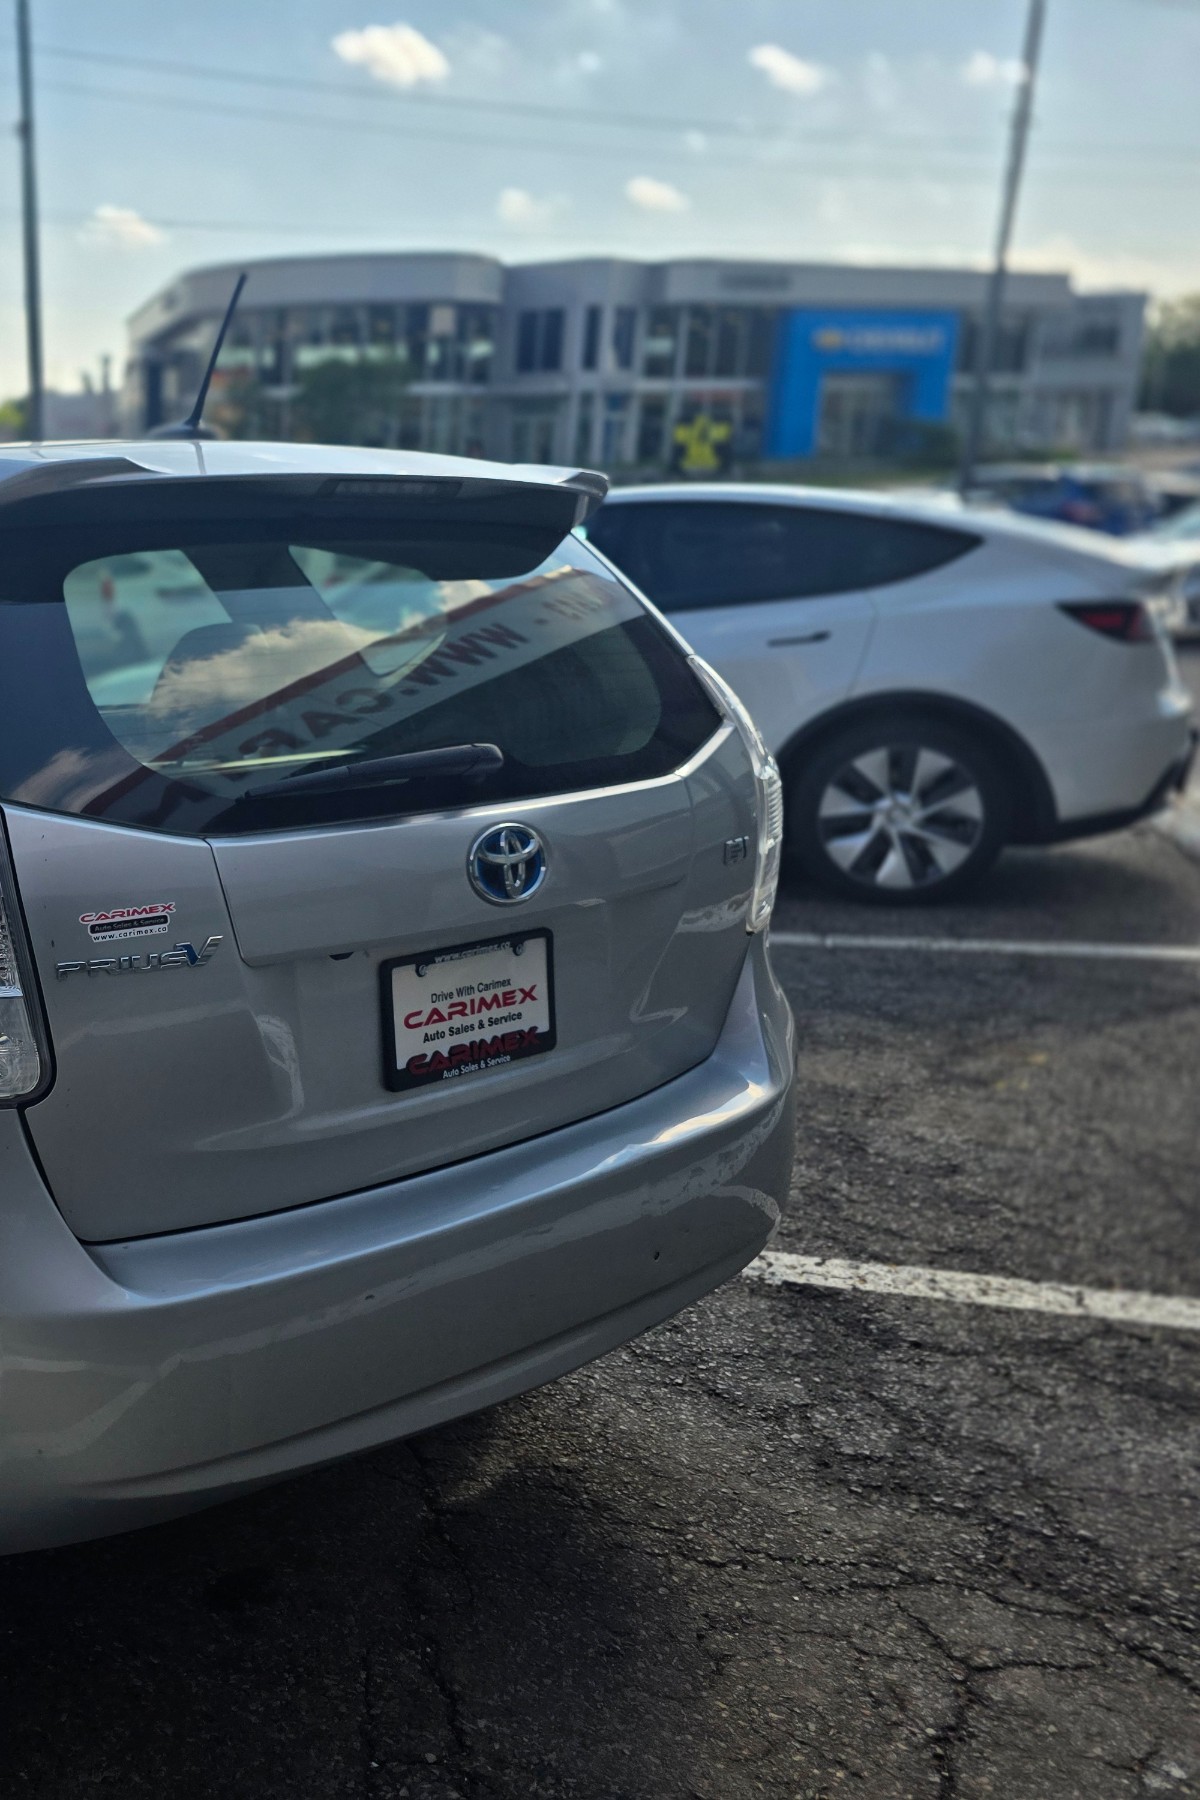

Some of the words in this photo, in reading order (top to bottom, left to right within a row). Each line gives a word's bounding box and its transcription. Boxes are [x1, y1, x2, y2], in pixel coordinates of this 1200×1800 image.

[79, 903, 175, 923] CARIMEX
[93, 925, 168, 941] www.carimex.ca
[94, 924, 112, 933] Auto
[430, 989, 455, 1004] Drive
[455, 984, 475, 997] With
[476, 977, 512, 993] Carimex
[403, 984, 538, 1030] CARIMEX
[423, 1030, 446, 1044] Auto
[448, 1022, 475, 1037] Sales
[477, 1019, 486, 1031] &
[487, 1011, 523, 1027] Service
[406, 1025, 540, 1076] CARIMEX
[442, 1069, 460, 1080] Auto
[460, 1063, 479, 1075] Sales
[480, 1061, 486, 1070] &
[487, 1054, 511, 1068] Service
